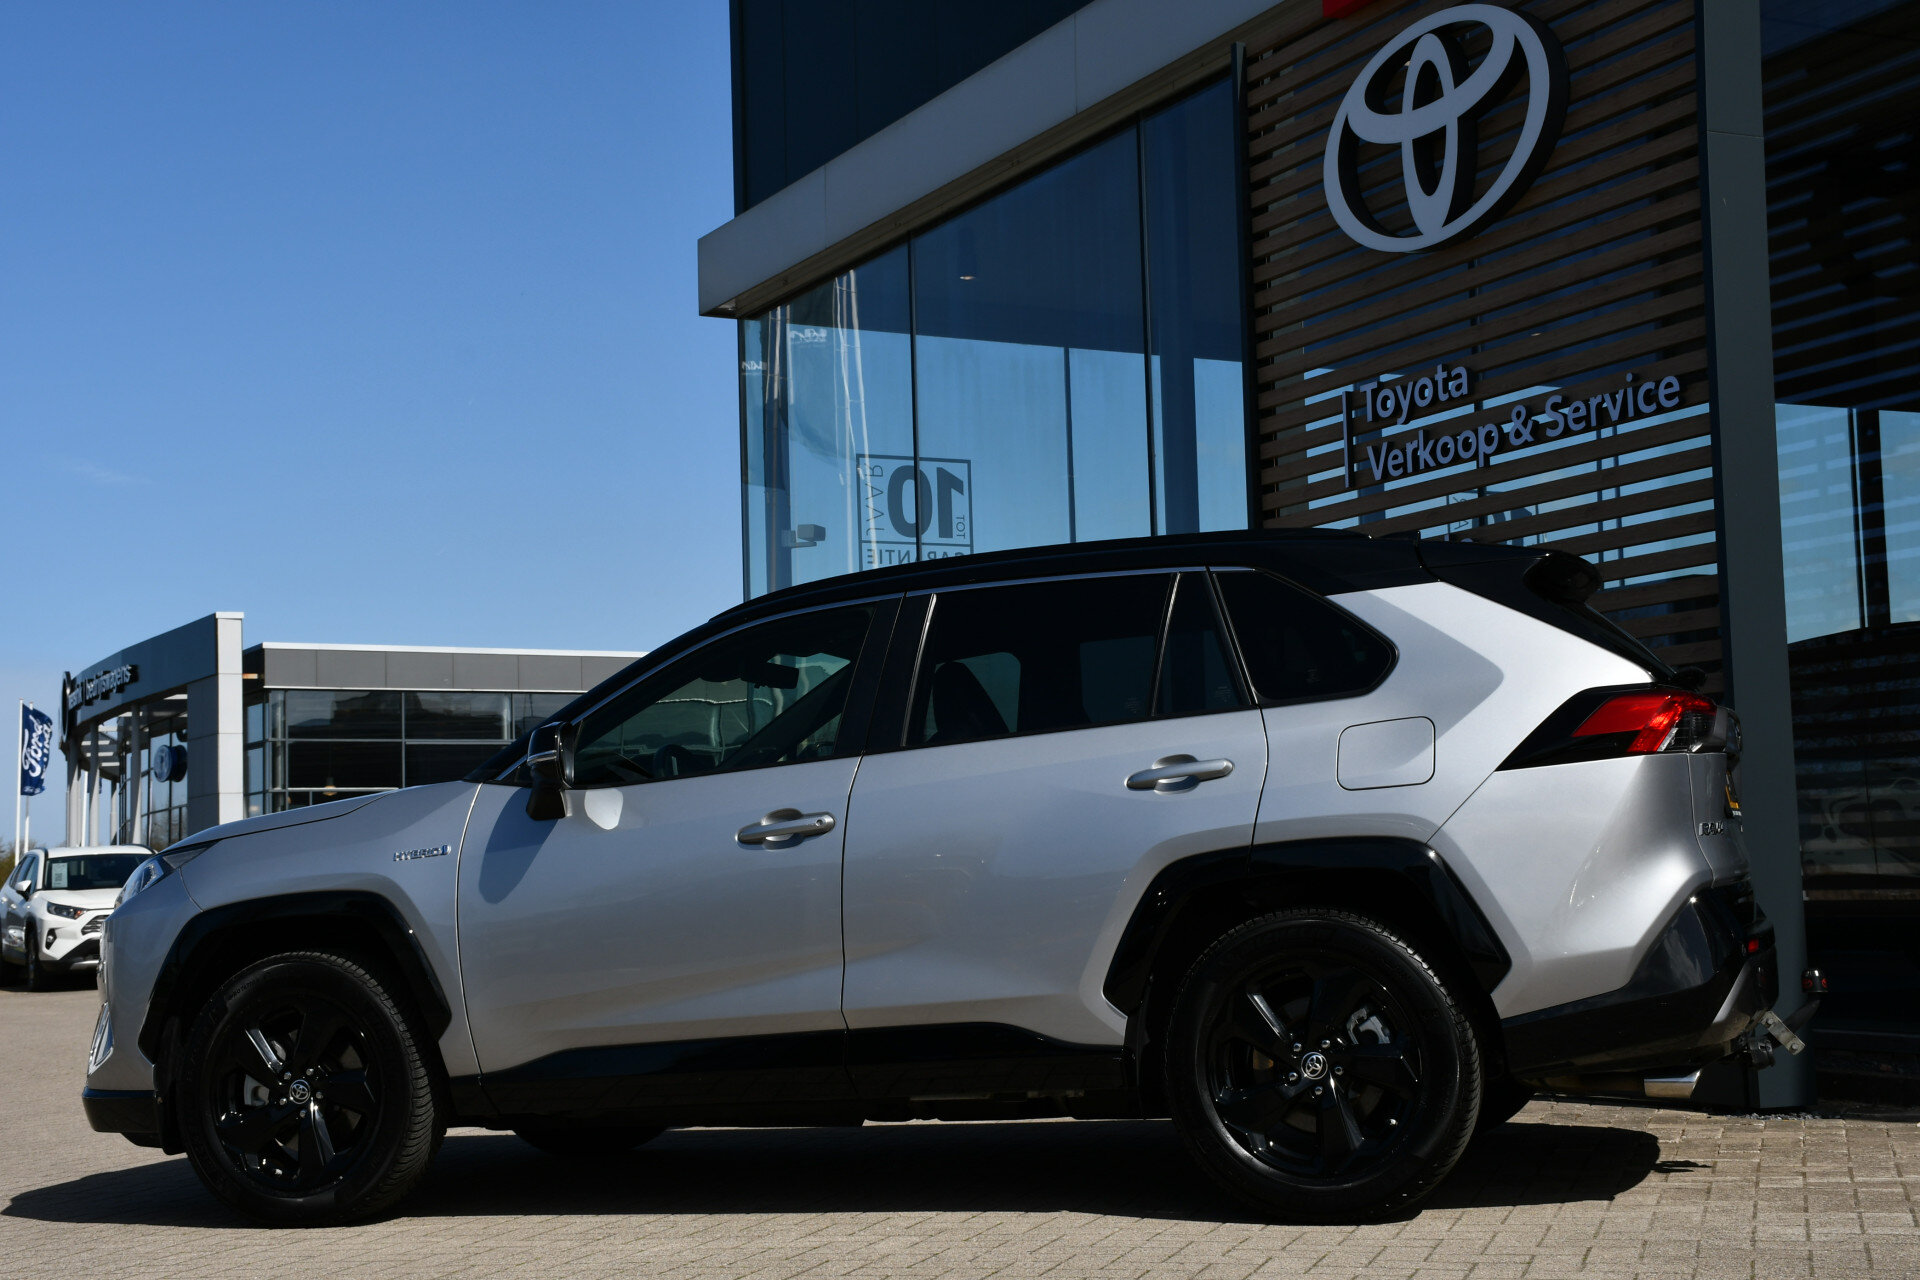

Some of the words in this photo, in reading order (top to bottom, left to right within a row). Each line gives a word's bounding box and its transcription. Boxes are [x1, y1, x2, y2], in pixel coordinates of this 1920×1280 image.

[1360, 364, 1469, 425] Toyota
[1367, 424, 1499, 481] Verkoop
[1509, 405, 1535, 446] &
[1545, 372, 1681, 437] Service
[22, 714, 43, 777] Ford
